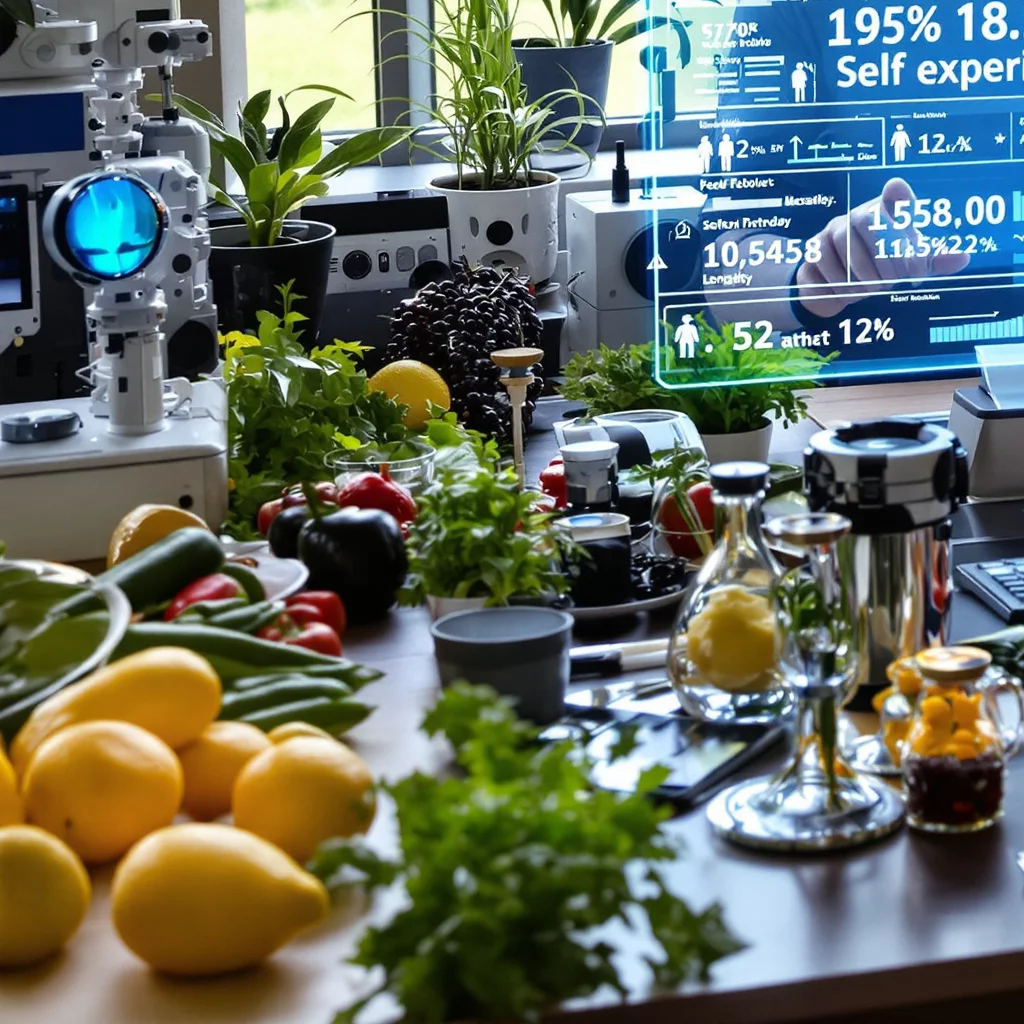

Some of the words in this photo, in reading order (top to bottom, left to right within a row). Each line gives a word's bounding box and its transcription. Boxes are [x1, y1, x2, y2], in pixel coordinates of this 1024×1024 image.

[827, 4, 942, 46] 195%
[837, 52, 907, 88] Self
[703, 239, 822, 270] 10,5458
[838, 317, 895, 345] 12%
